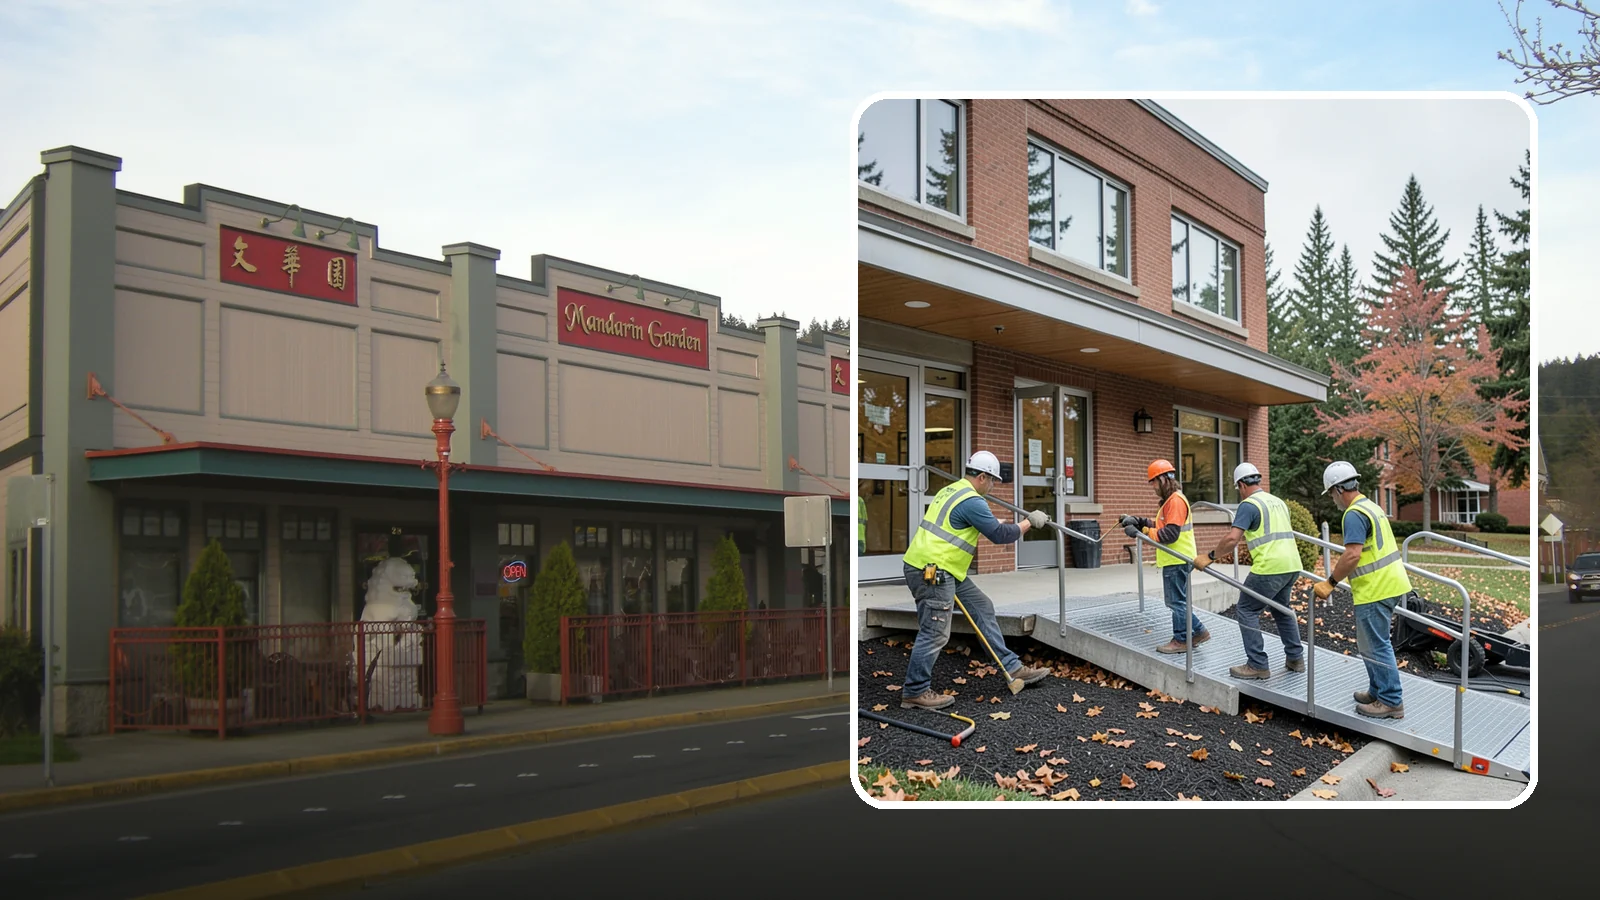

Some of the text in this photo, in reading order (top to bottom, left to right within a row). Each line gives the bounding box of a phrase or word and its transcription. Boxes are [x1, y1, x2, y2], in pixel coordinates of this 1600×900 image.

[231, 236, 346, 290] 文華園
[565, 302, 702, 352] Mandarin Garden
[503, 565, 527, 578] OPEN
